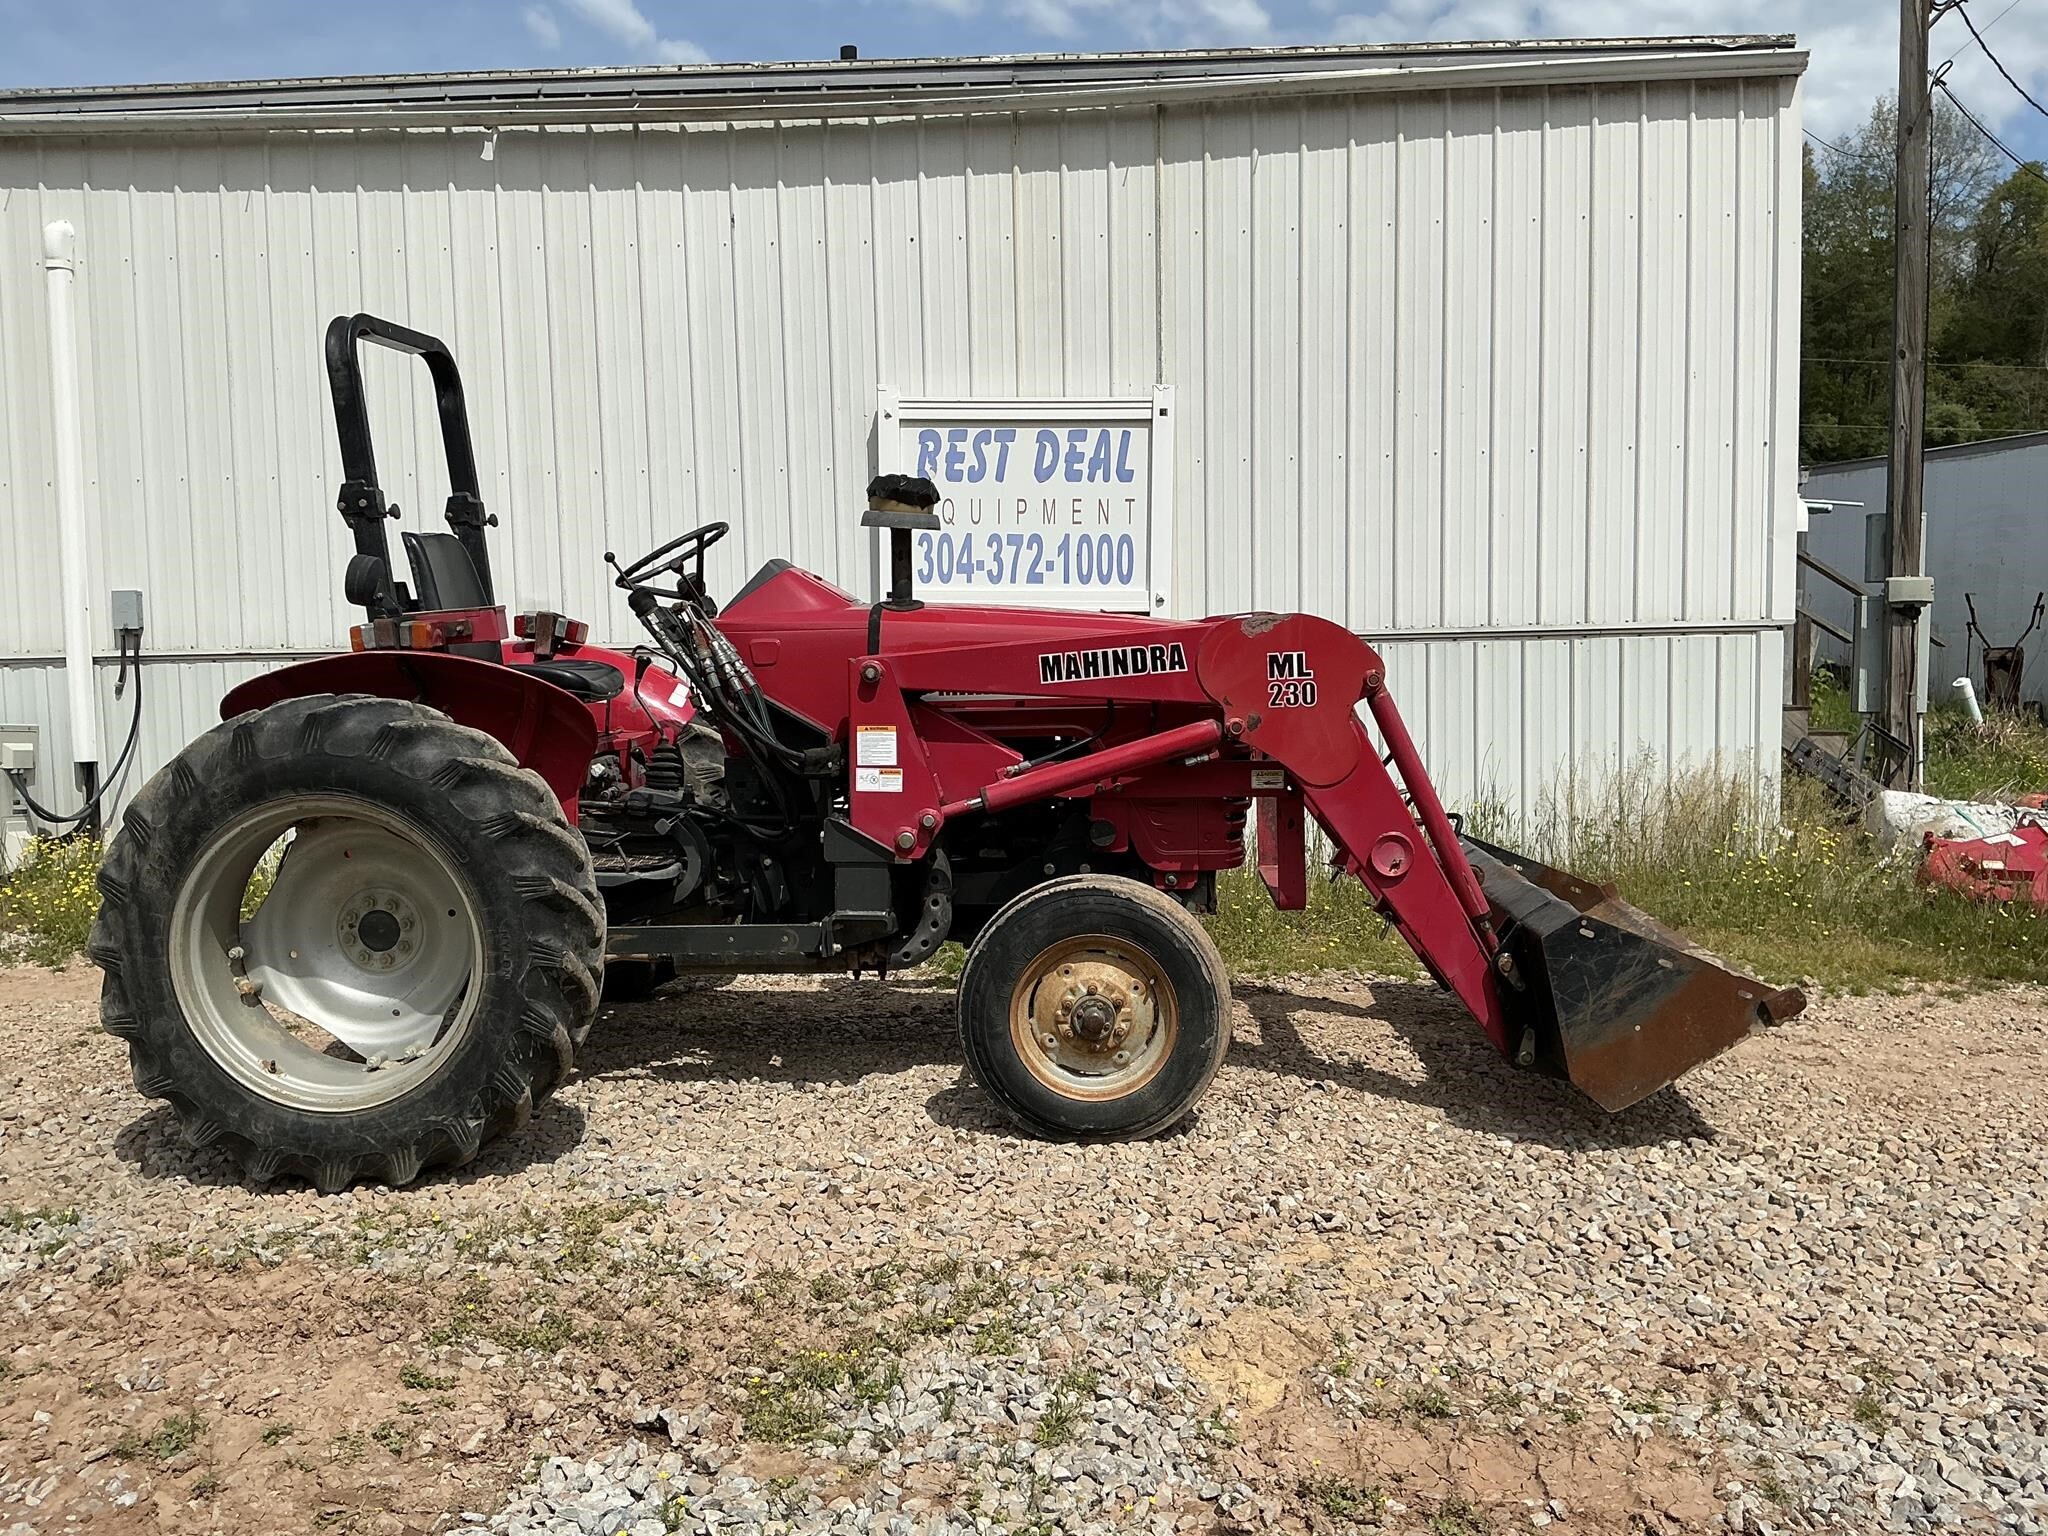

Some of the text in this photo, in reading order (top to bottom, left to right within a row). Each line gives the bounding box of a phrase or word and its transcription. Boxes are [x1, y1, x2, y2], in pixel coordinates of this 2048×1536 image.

[917, 429, 1135, 483] BEST DEAL
[941, 498, 1136, 525] QUIPMENT
[917, 533, 1134, 585] 304-372-1000
[1039, 643, 1187, 684] MAHINDRA
[1267, 652, 1313, 681] ML
[1268, 681, 1317, 707] 230
